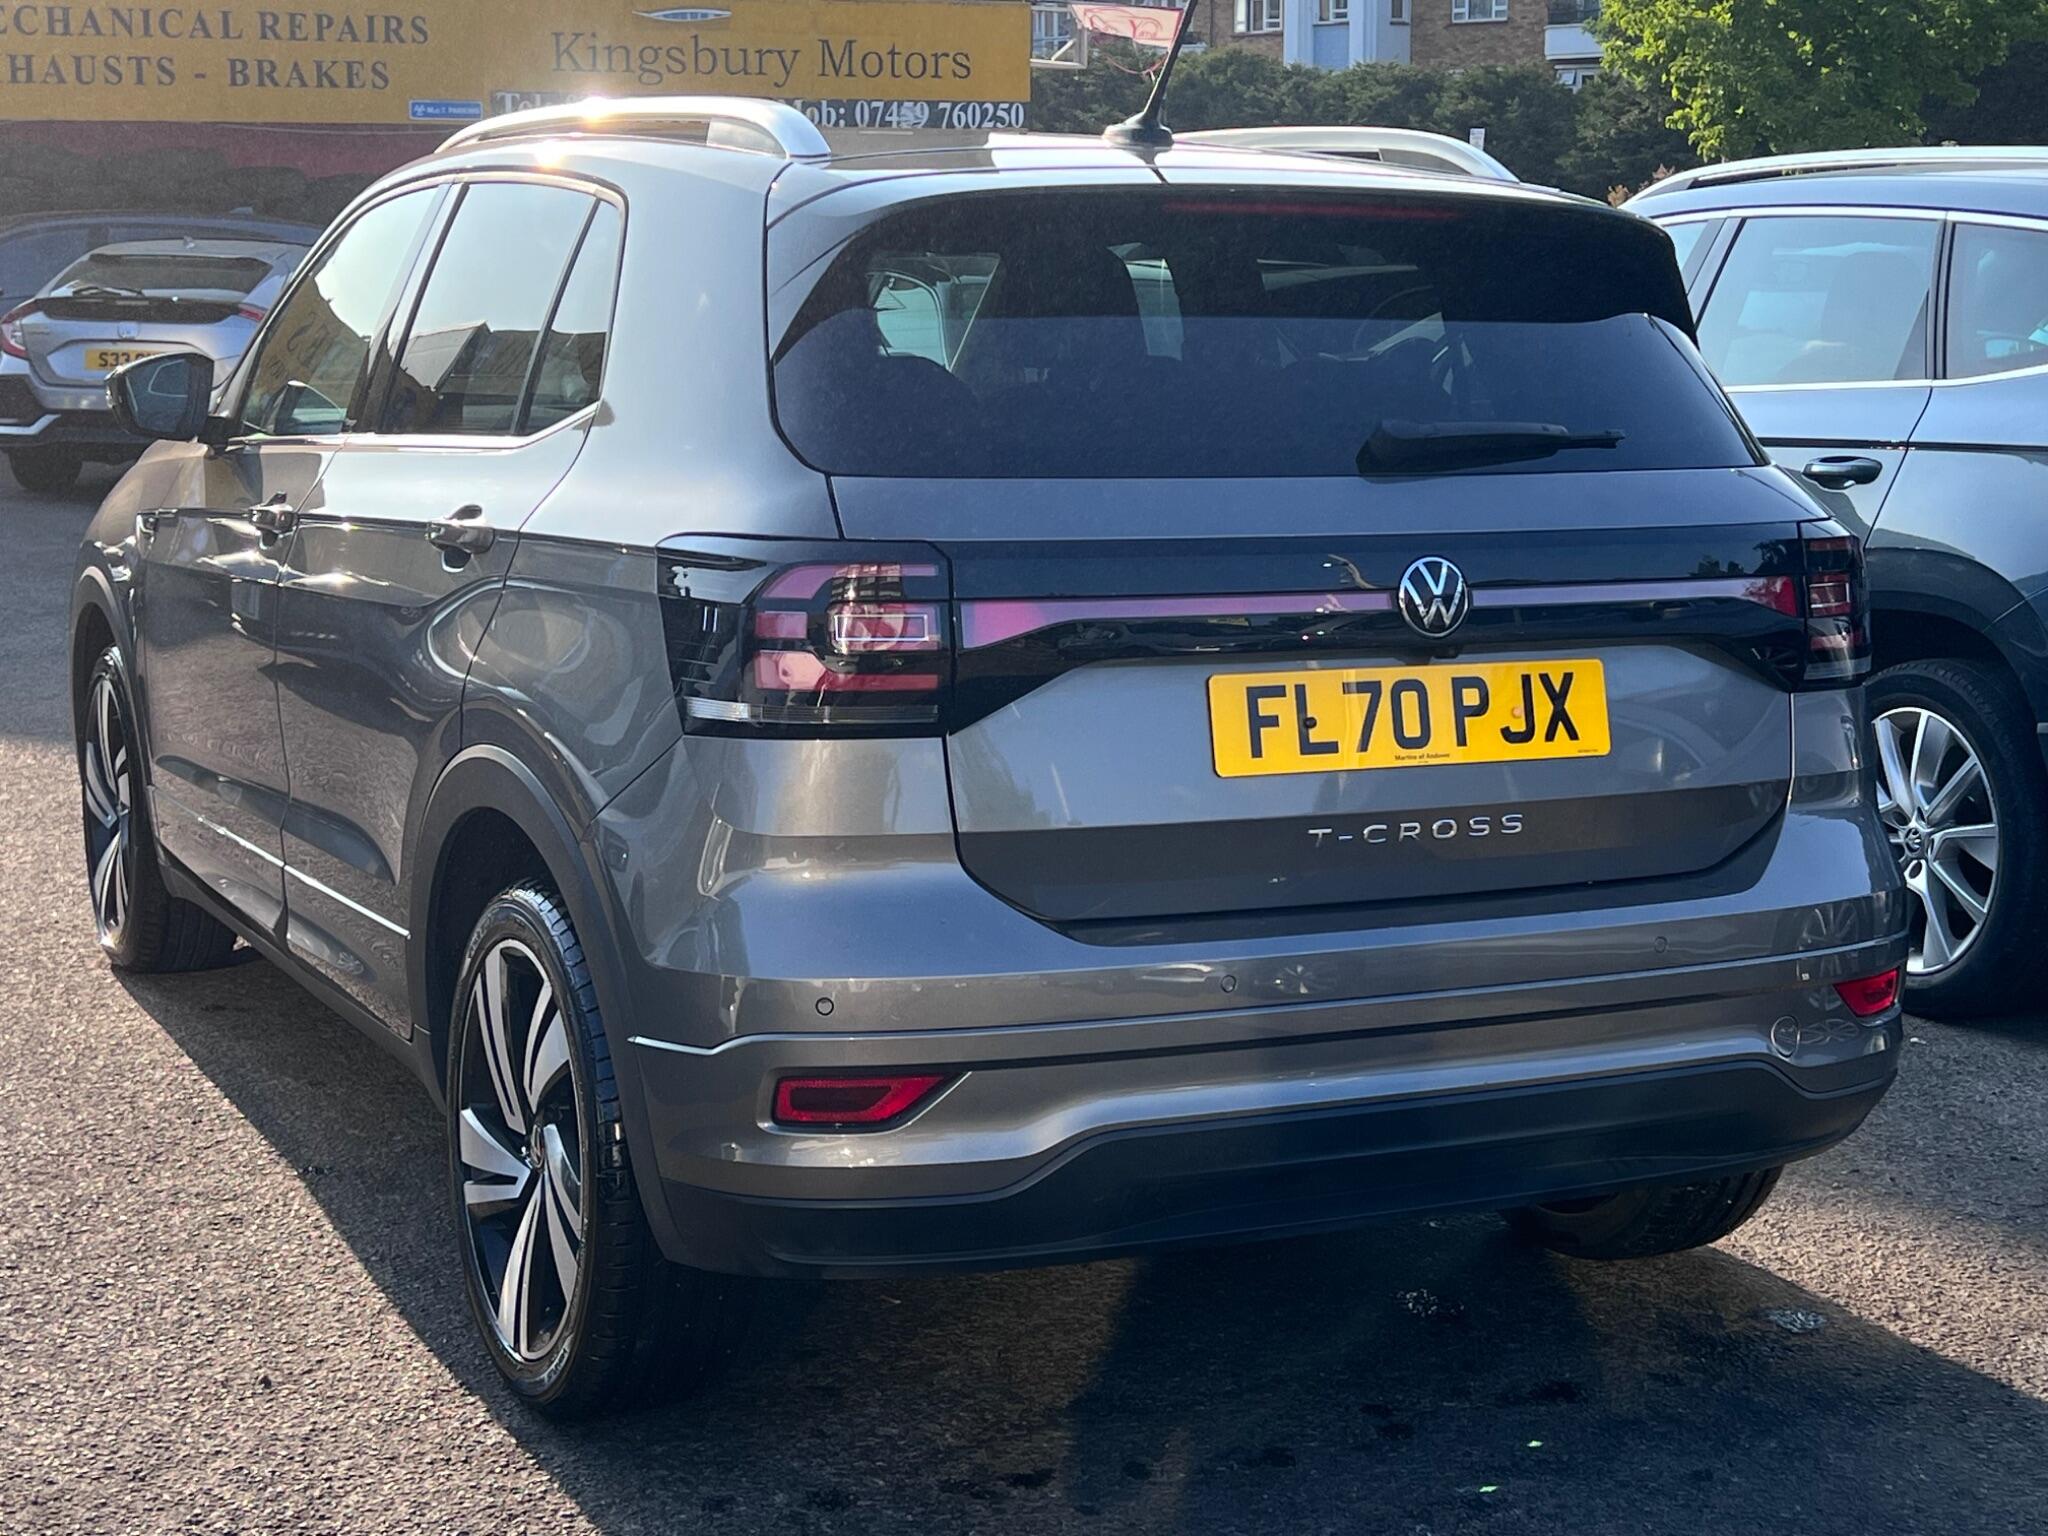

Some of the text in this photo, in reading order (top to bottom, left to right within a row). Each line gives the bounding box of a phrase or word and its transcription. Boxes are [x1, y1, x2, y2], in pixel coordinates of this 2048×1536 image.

[0, 4, 430, 45] CHANICAL REPAIRS
[0, 54, 176, 86] HAUSTS
[228, 58, 390, 90] BRAKES
[551, 31, 973, 88] Kingsbury Motors
[792, 101, 846, 128] ob:
[938, 102, 1025, 129] 760250
[1246, 672, 1580, 759] FL70 PJX
[1307, 814, 1525, 847] T-CROSS
